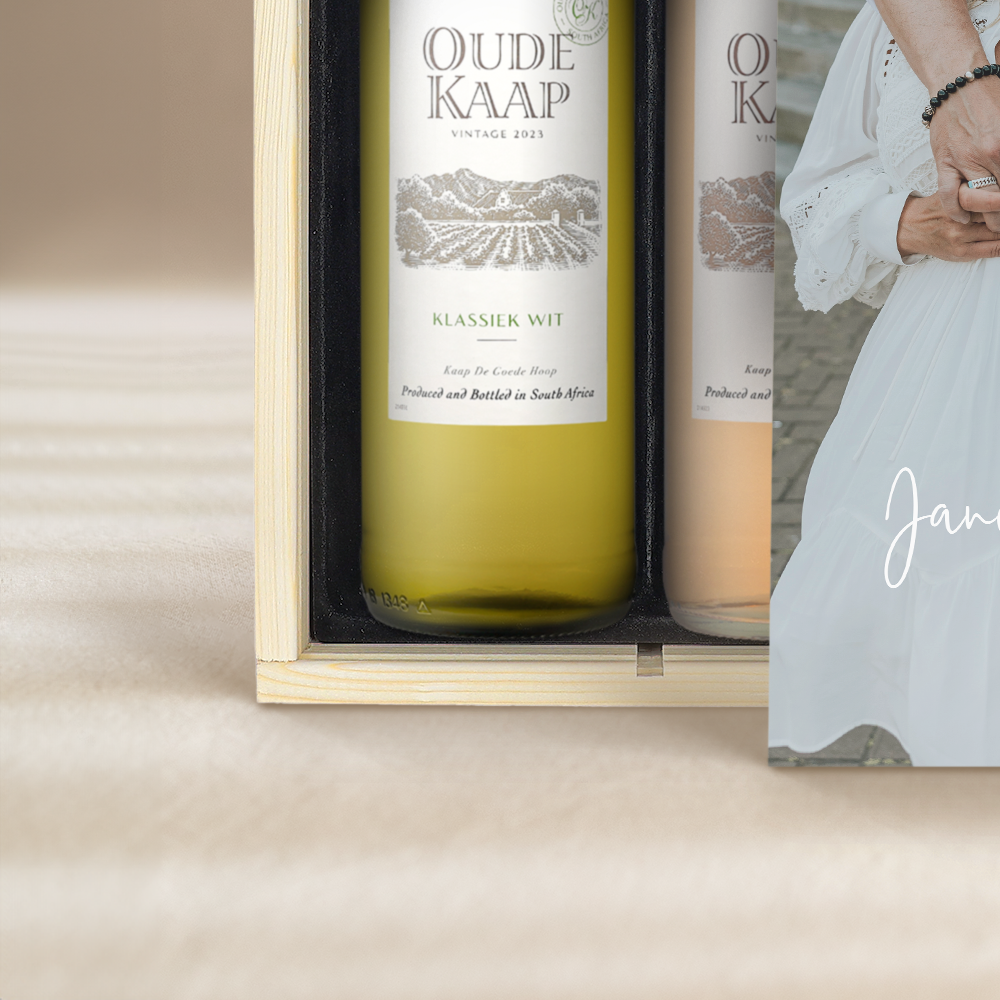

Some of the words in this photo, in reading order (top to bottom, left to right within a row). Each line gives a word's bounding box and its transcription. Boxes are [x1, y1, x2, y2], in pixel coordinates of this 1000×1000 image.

[423, 26, 575, 71] OUDE
[727, 33, 777, 76] O
[427, 75, 571, 119] KAAP
[731, 80, 777, 124] K
[451, 130, 507, 139] VINTAGE
[514, 130, 544, 139] 2023
[432, 312, 520, 327] KLASSIEK
[528, 312, 564, 327] WIT
[443, 365, 471, 378] Kaap
[474, 366, 489, 376] De
[529, 366, 557, 378] Hoop
[744, 364, 772, 377] Kaap
[401, 385, 443, 399] Produced
[446, 388, 467, 400] and
[470, 388, 511, 401] Bottled
[514, 389, 526, 400] in
[530, 387, 563, 400] South
[564, 386, 594, 401] Africa
[705, 385, 748, 400] Produced
[750, 388, 772, 400] and
